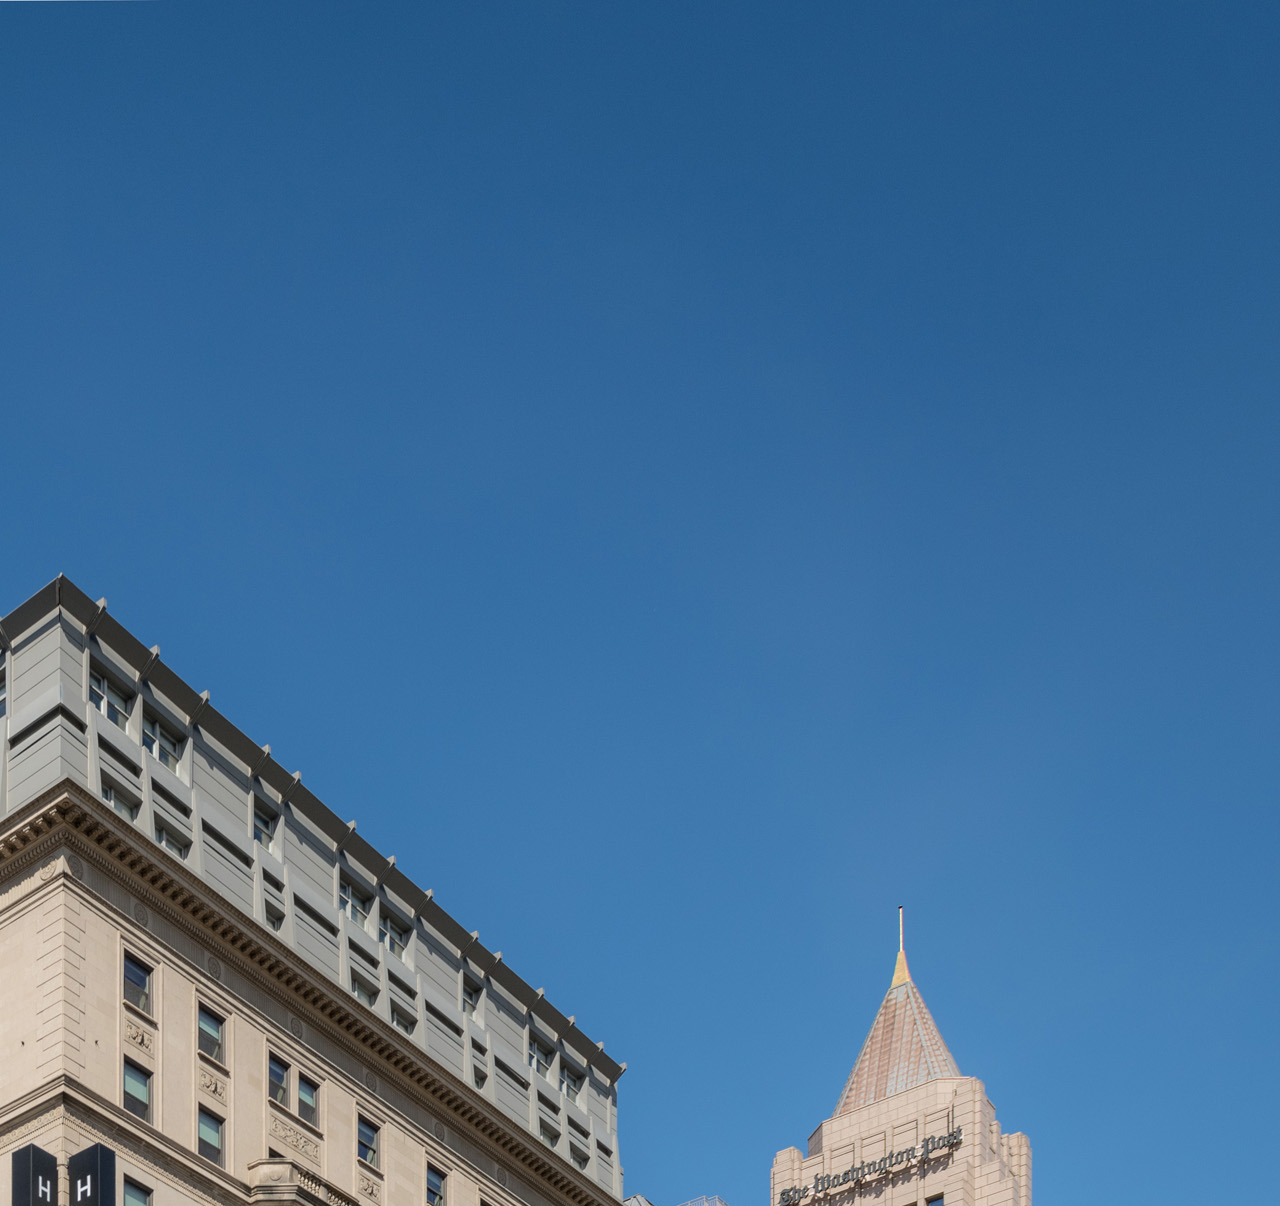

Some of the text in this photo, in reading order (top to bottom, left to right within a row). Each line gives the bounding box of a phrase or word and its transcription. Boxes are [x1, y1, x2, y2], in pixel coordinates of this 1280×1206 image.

[778, 1125, 963, 1206] The Washington Post
